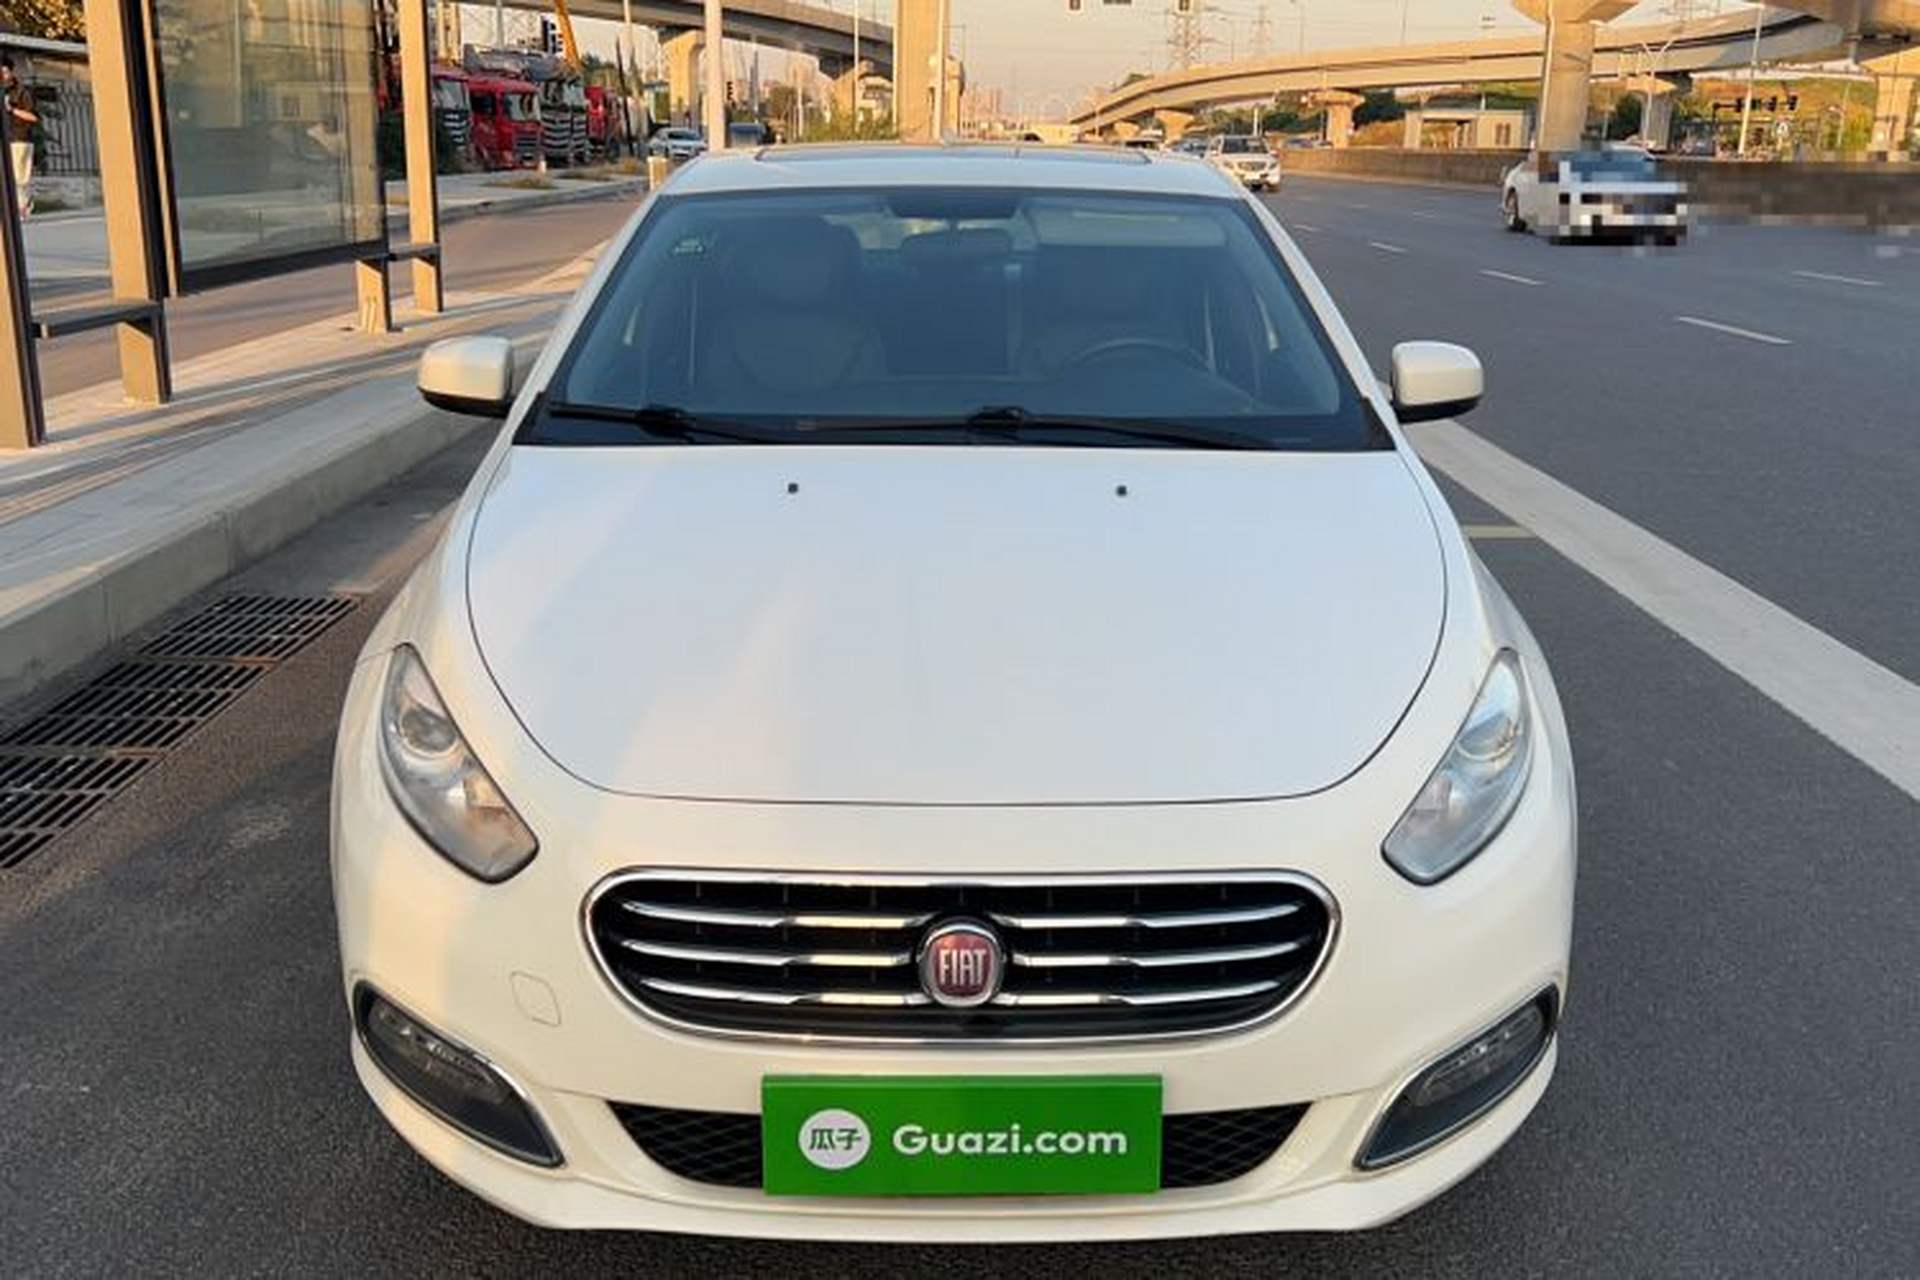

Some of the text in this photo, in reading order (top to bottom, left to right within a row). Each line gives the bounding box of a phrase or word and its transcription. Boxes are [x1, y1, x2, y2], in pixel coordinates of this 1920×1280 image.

[940, 949, 986, 985] FIAT
[809, 1123, 1127, 1155] 瓜子 Guazi.com
